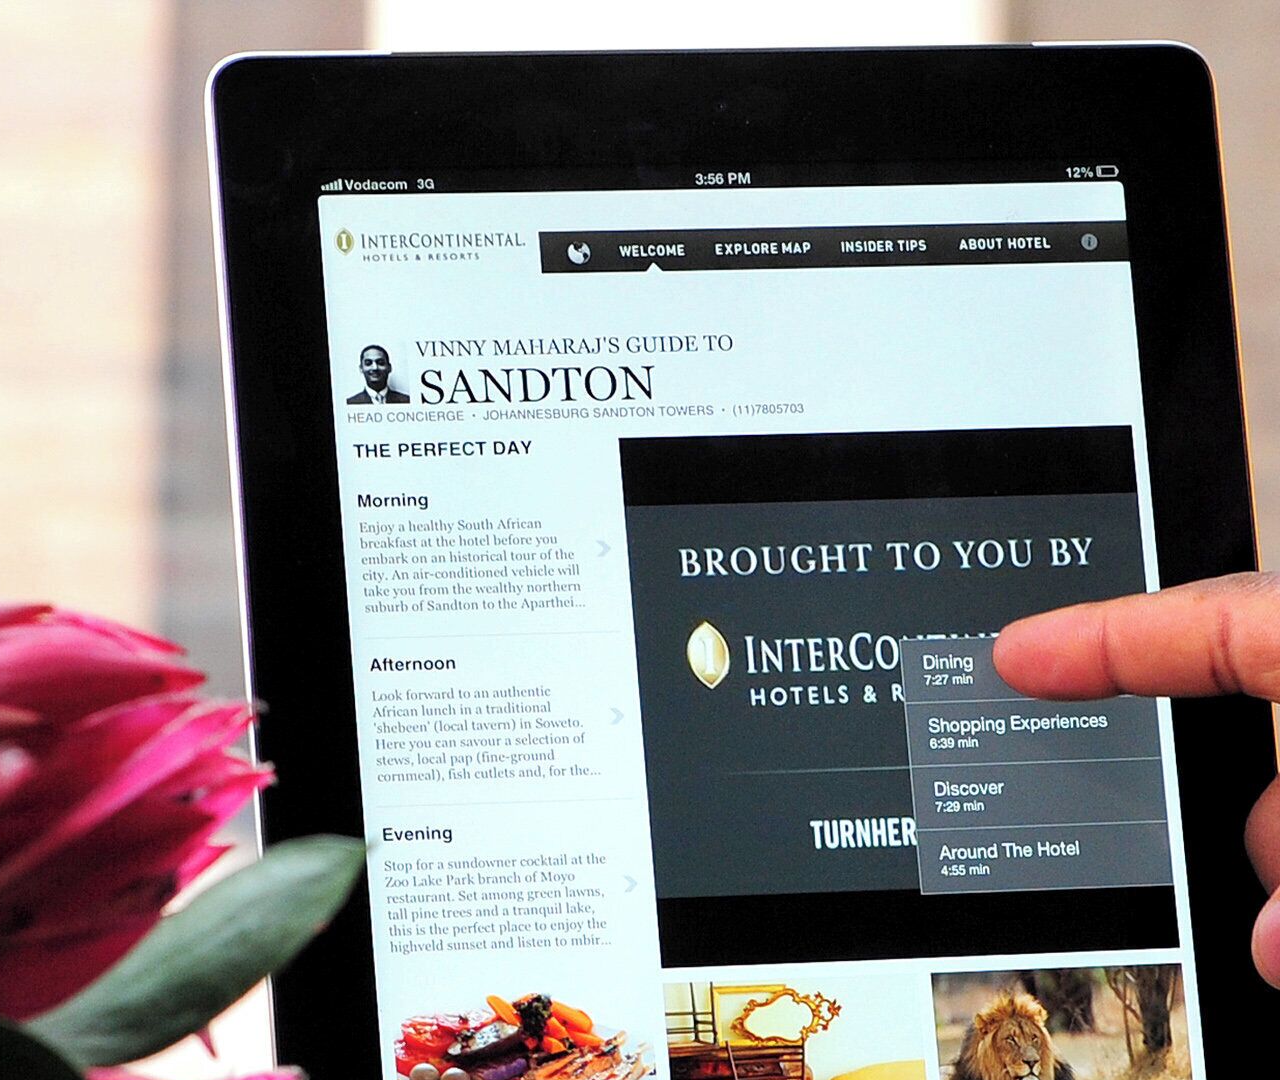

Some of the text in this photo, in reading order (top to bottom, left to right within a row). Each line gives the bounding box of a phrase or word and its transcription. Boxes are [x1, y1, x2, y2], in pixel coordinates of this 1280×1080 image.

[695, 172, 751, 185] 3:56 PM
[1065, 166, 1094, 178] 12%
[344, 178, 435, 191] Vodacom 3G
[619, 244, 685, 256] WELCOME
[715, 242, 810, 255] EXPLORE MAP
[840, 239, 926, 252] INSIDER TIPS
[959, 237, 1050, 250] ABOUT HOTEL
[363, 253, 408, 261] HOTELS
[428, 252, 479, 260] RESORTS
[416, 335, 732, 356] VINNY MAHARAJ'S GUIDE TO
[420, 365, 654, 404] SANDTON
[347, 403, 804, 423] HEAD CONCIERGE JOHANNESBURG SANDTON TOWERS (11)7805703
[353, 440, 531, 458] THE PERFECT DAY
[357, 493, 428, 510] Morning
[359, 518, 541, 535] Enjoy a healthy South African
[360, 534, 557, 549] breakfast at the hotel before you
[361, 548, 574, 565] embark on an historical tour of the
[679, 537, 1092, 576] BROUGHT TO YOU BY
[362, 564, 579, 583] city. An air-conditioned vehicle will
[370, 658, 455, 671] Afternoon
[923, 654, 973, 672] Dining
[923, 673, 973, 685] 7:27 min
[372, 685, 550, 701] Look forward to an authentic
[750, 685, 848, 706] HOTELS
[863, 684, 876, 702] &
[373, 701, 550, 717] African lunch in a traditional
[434, 719, 467, 733] (local
[471, 718, 516, 731] tavern)
[520, 718, 531, 729] in
[535, 718, 583, 728] Soweto.
[928, 714, 1107, 735] Shopping Experiences
[375, 739, 405, 750] Here
[409, 740, 431, 751] you
[435, 739, 456, 748] can
[460, 738, 501, 747] savour
[515, 733, 569, 745] selection
[573, 732, 584, 743] of
[929, 736, 978, 749] 6:39 min
[934, 781, 1004, 796] Discover
[935, 800, 984, 812] 7:29 min
[382, 826, 452, 843] Evening
[939, 840, 1079, 860] Around The Hotel
[384, 860, 412, 873] Stop
[416, 858, 434, 870] for
[447, 856, 516, 869] sundowner
[520, 854, 567, 867] cocktail
[571, 855, 582, 864] at
[586, 853, 605, 864] the
[941, 863, 990, 876] 4:55 min
[385, 871, 575, 887] Zoo Lake Park branch of Moyo
[386, 886, 604, 904] restaurant. Set among green lawns,
[388, 902, 594, 922] tall pine trees and a tranquil lake,
